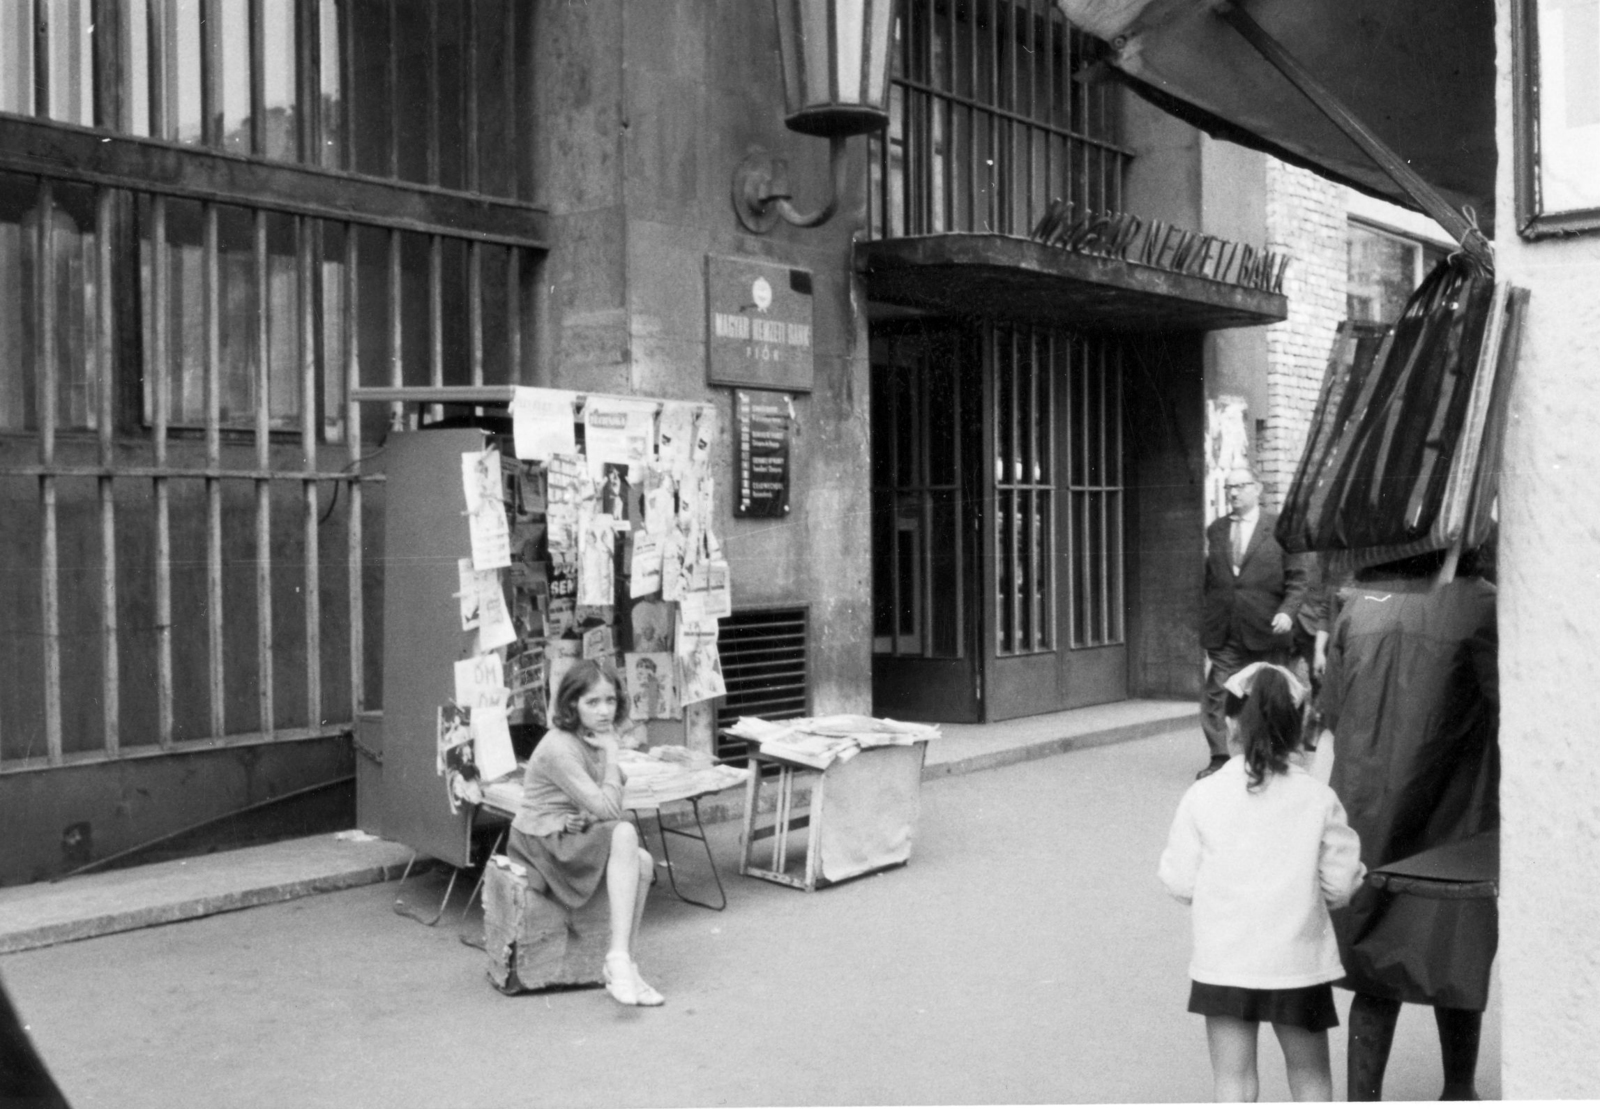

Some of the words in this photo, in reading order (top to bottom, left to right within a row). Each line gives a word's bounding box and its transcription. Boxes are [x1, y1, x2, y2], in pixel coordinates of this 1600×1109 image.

[1141, 218, 1239, 281] NEMZETI
[1236, 243, 1291, 293] BANK
[715, 312, 749, 339] MAGYAR
[752, 319, 786, 344] NEMZETI
[787, 323, 809, 346] BANK
